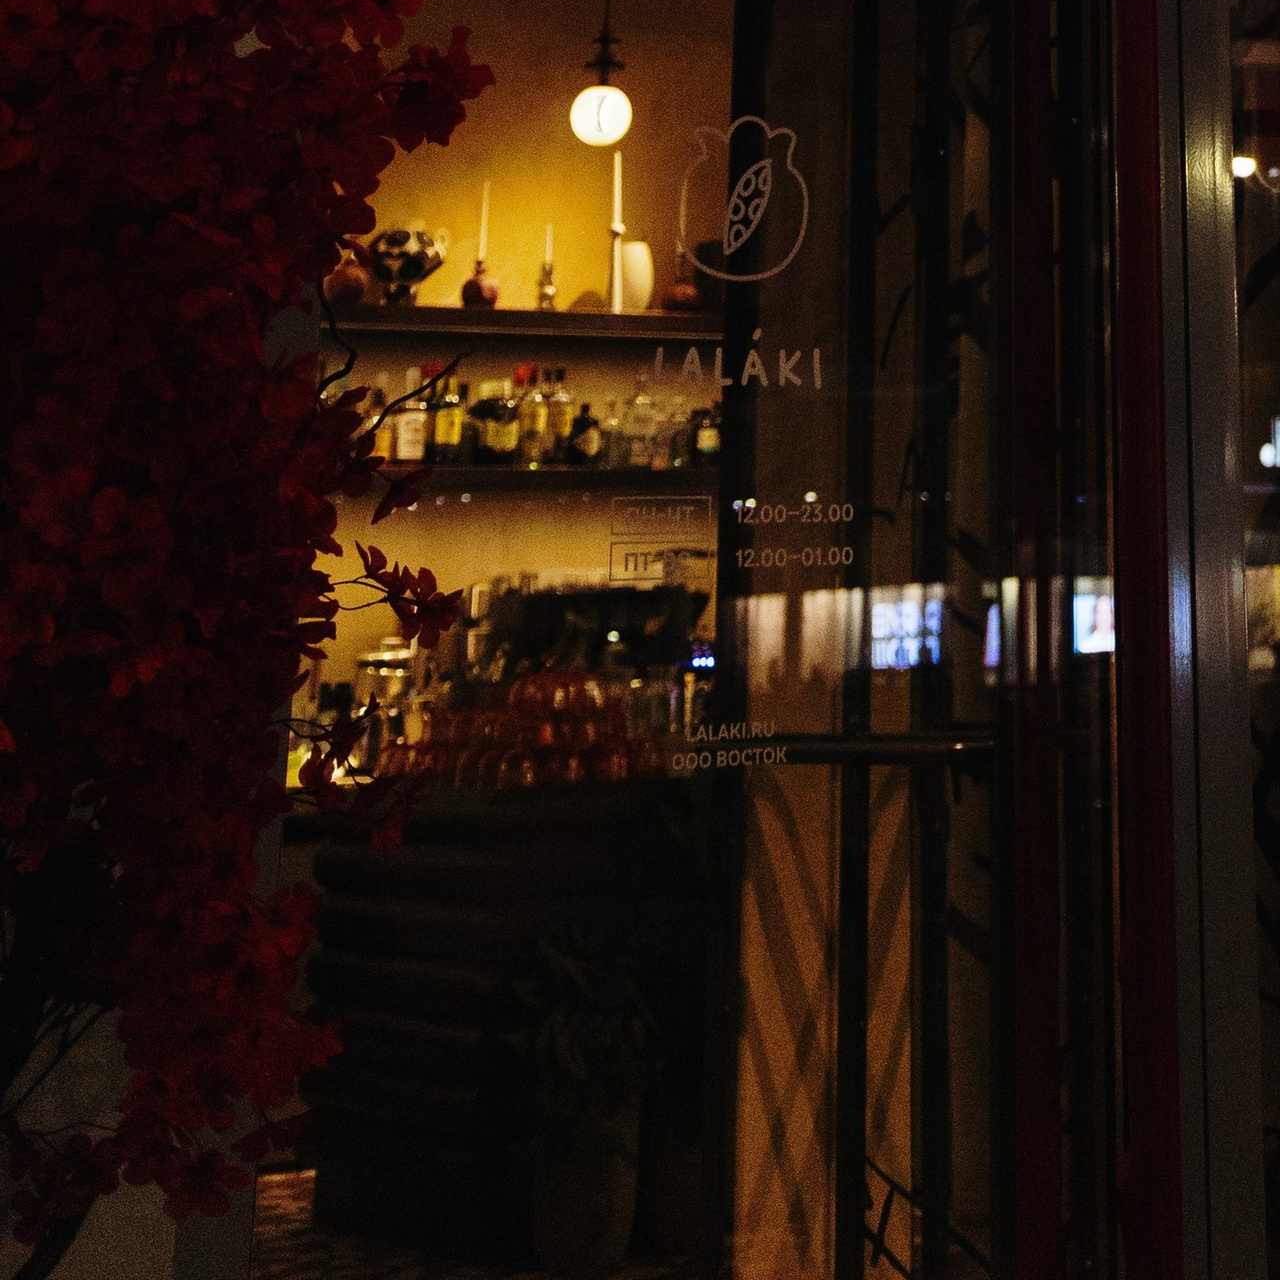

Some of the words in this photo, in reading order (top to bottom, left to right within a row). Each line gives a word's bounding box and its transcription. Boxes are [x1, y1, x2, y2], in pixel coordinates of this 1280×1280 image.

[685, 721, 775, 742] LALAKI.RU
[672, 751, 712, 770] ООО
[716, 746, 788, 767] ВОСТОК
